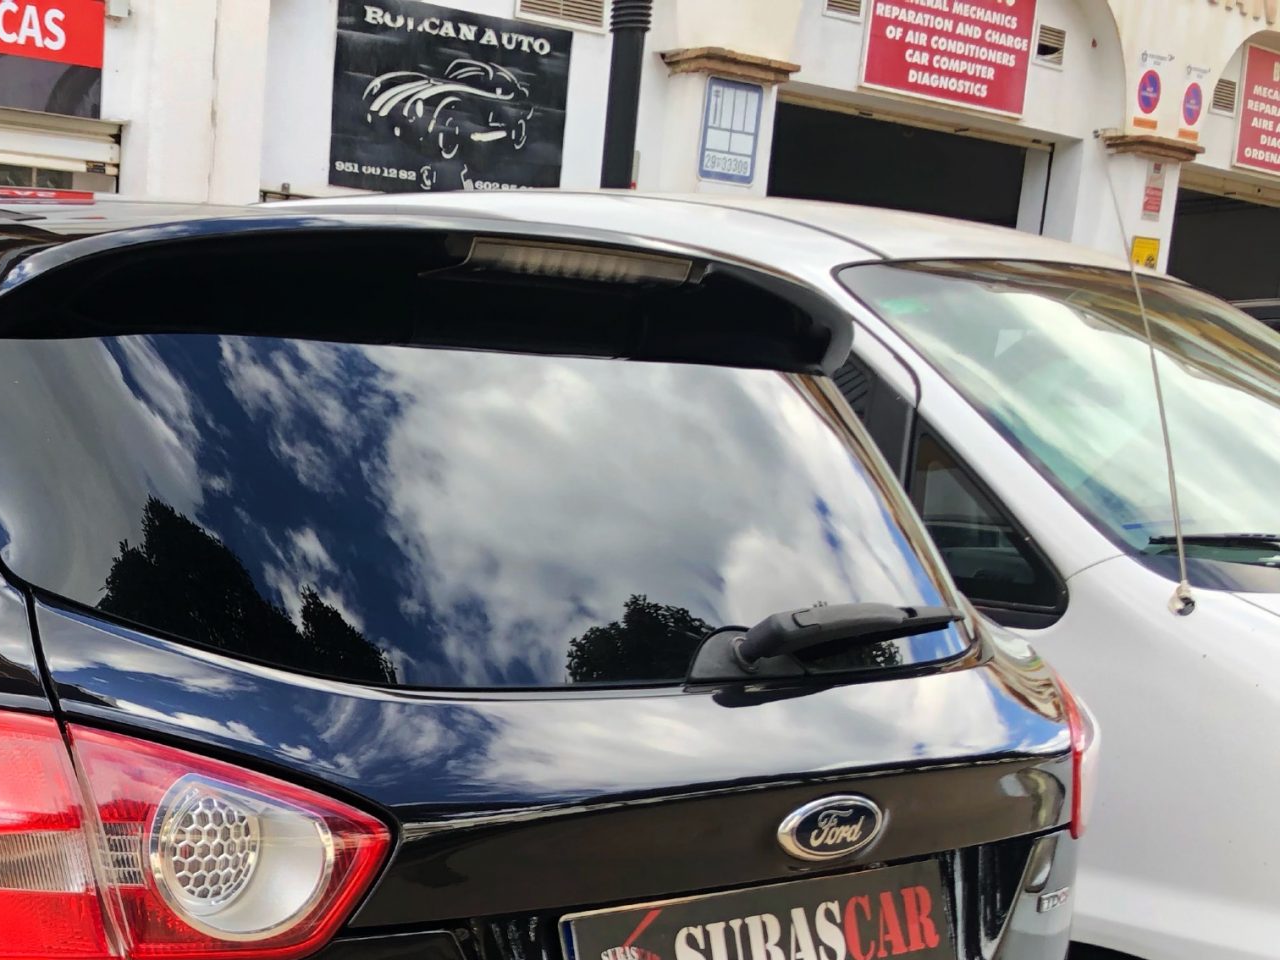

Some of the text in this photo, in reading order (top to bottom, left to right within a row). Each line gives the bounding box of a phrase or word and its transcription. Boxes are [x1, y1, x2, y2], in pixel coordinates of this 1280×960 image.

[876, 3, 1028, 51] REPARATION AND CHARGE
[952, 1, 1017, 29] MECHANICS
[479, 28, 551, 55] AUTO
[885, 25, 1016, 67] OF AIR CONDITIONERS
[905, 49, 995, 80] CAR COMPUTER
[908, 69, 988, 97] DIAGNOSTICS
[1251, 117, 1274, 132] AIRE
[335, 160, 359, 174] 951
[809, 808, 866, 848] Ford
